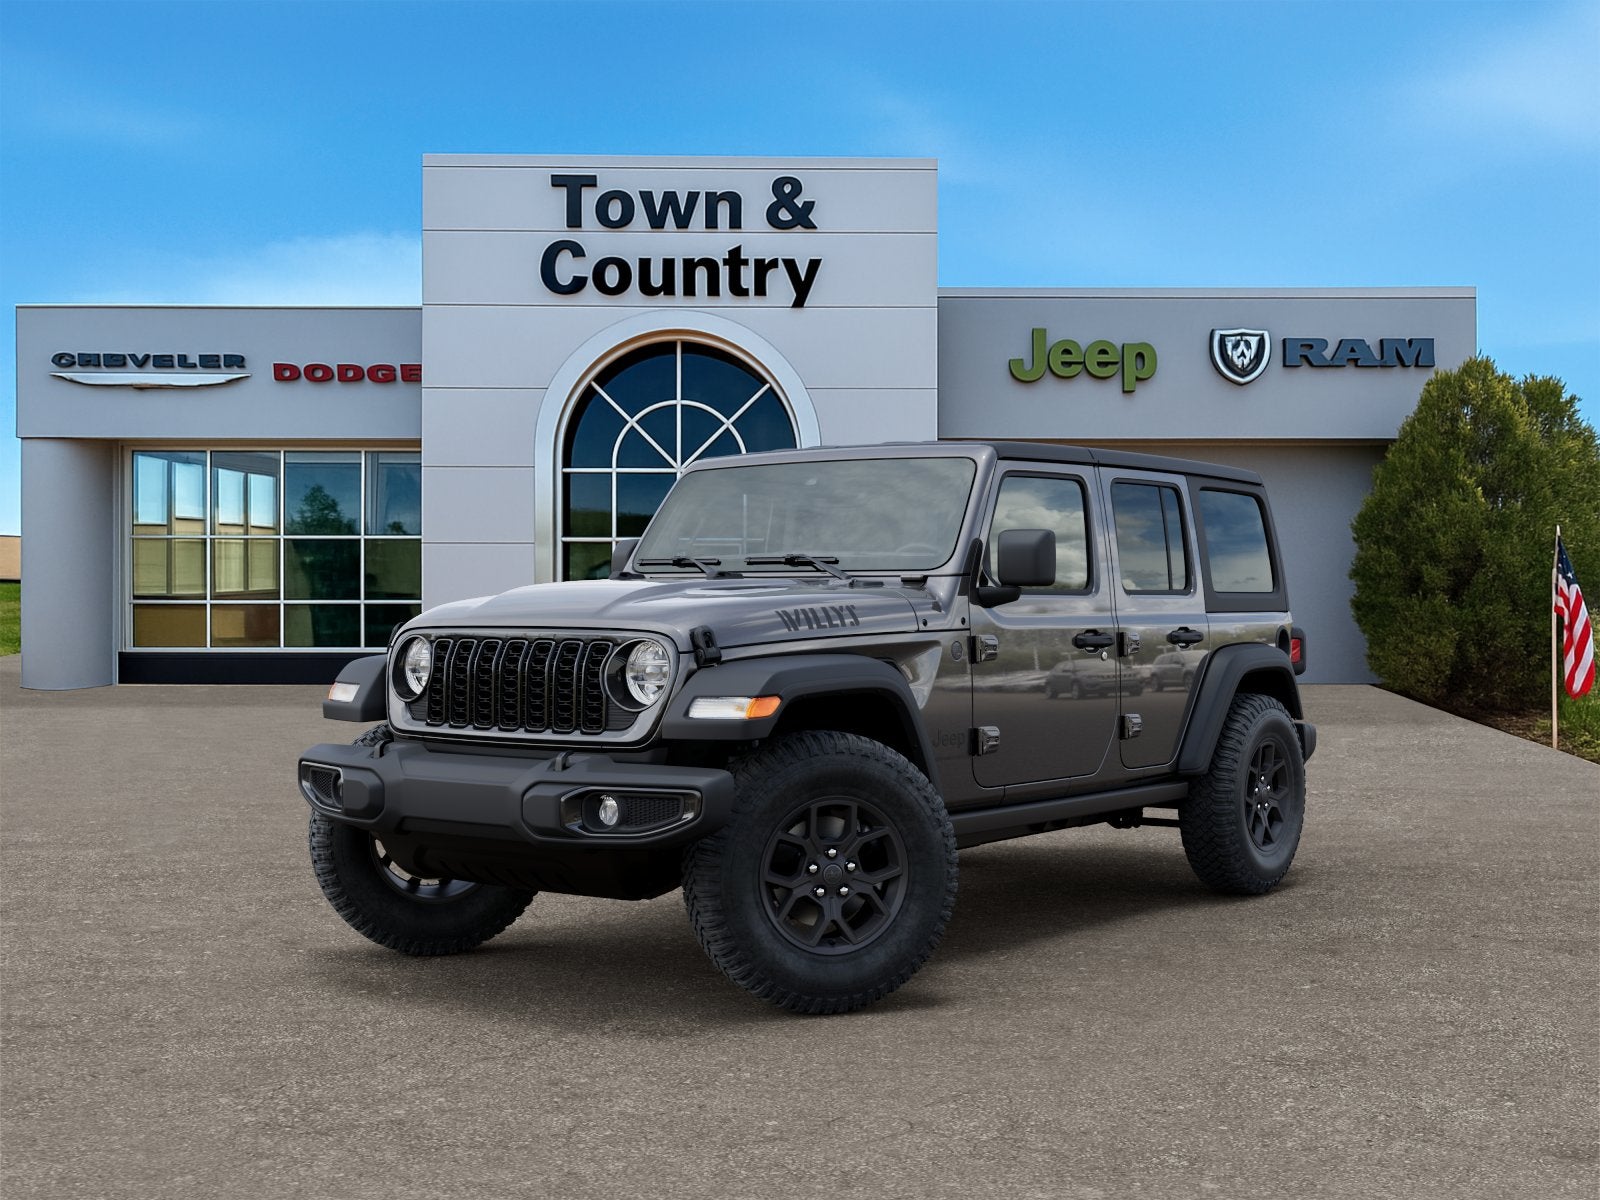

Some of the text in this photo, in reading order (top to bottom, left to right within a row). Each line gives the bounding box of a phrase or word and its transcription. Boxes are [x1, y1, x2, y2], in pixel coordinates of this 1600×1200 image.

[550, 174, 818, 230] Town &
[540, 239, 822, 308] Country
[1009, 328, 1157, 393] Jeep
[1282, 337, 1436, 368] RAM
[273, 362, 422, 383] DODGE
[775, 604, 860, 632] WILLYS
[930, 727, 966, 749] Jeep
